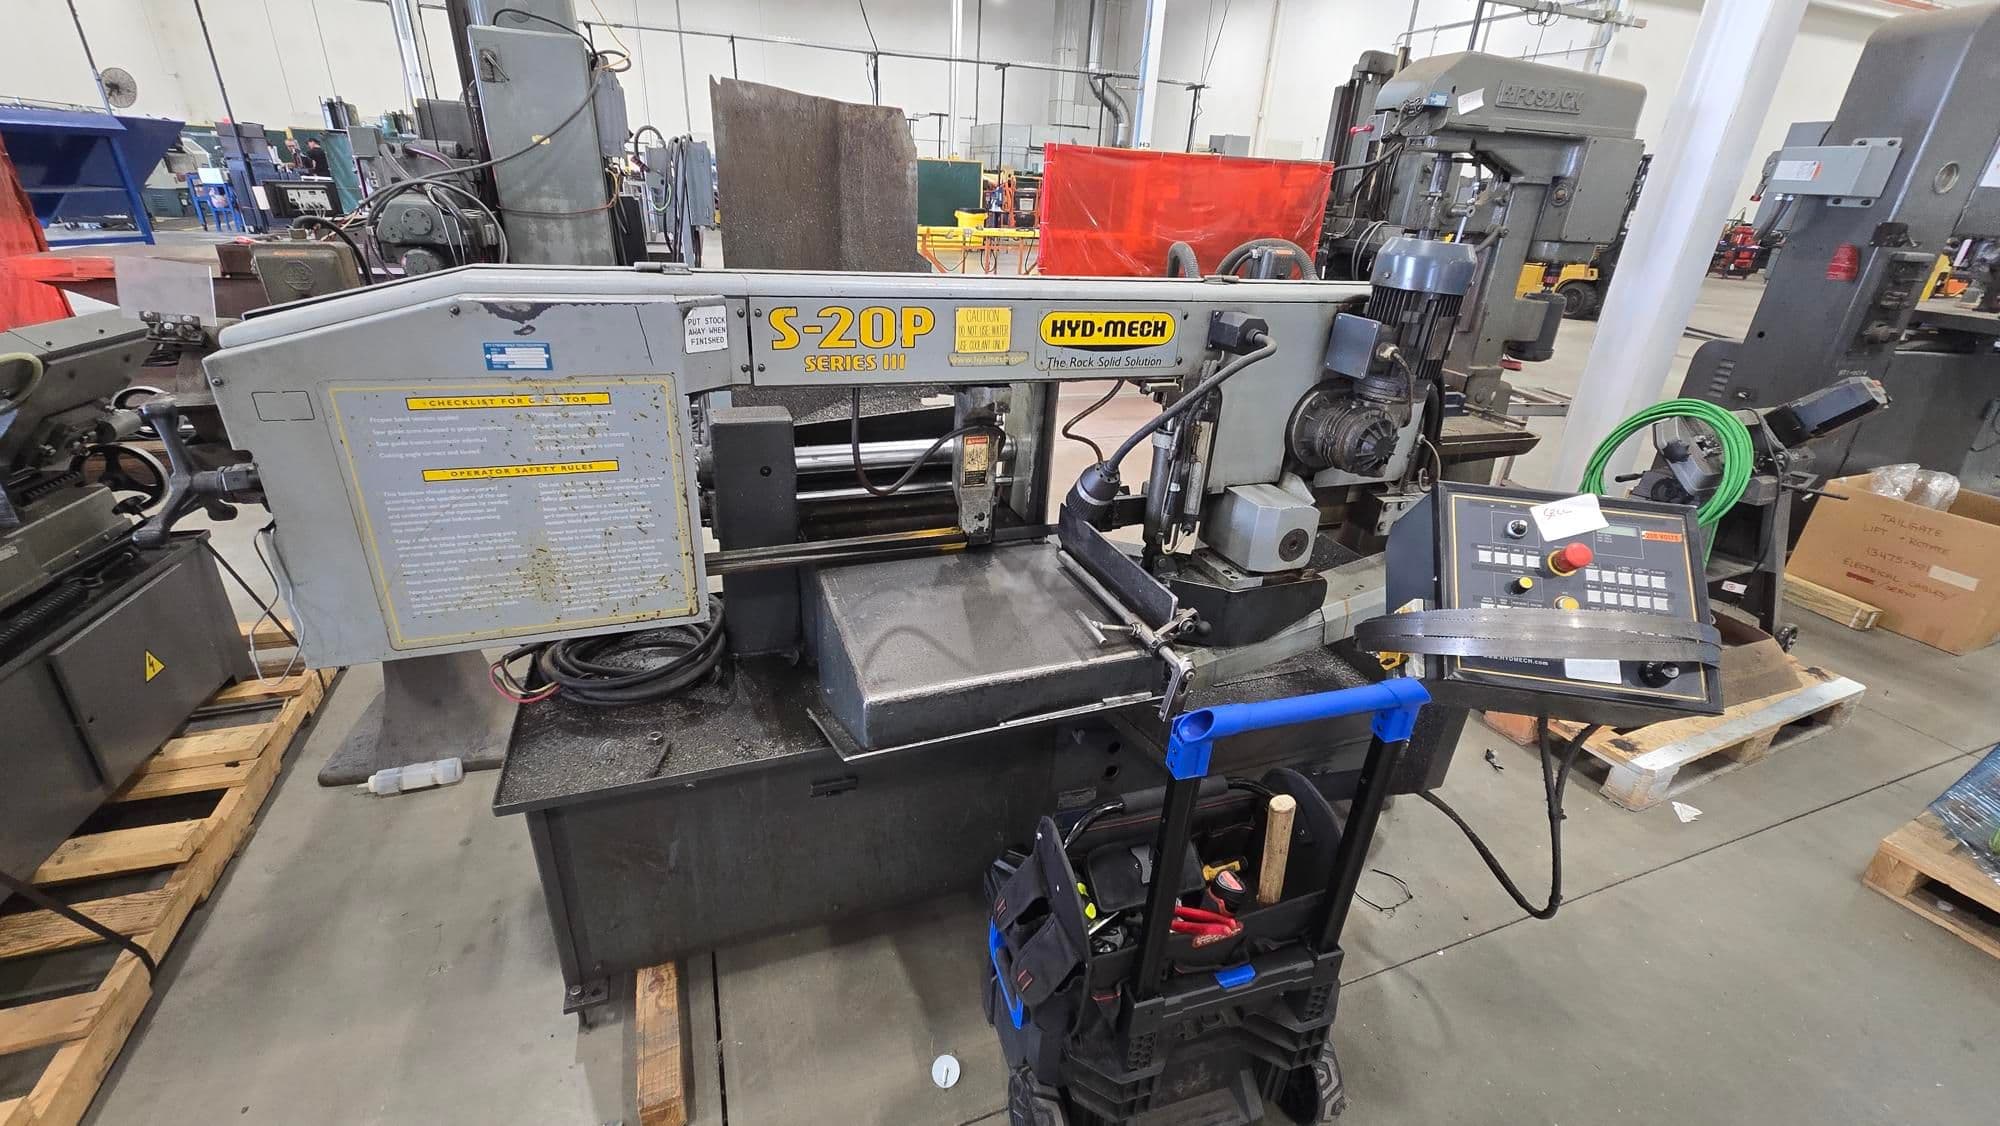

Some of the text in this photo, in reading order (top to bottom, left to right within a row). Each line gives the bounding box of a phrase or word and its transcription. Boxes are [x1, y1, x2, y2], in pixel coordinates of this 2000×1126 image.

[687, 316, 725, 326] PUT STOCK
[966, 309, 1000, 323] CAUTION
[688, 326, 726, 336] AWAY WHEN
[768, 305, 936, 350] S-20P
[967, 325, 977, 336] NOT
[691, 336, 725, 346] FINISHED
[804, 352, 906, 372] SERIES III
[1047, 356, 1162, 368] The Rock Solid Solution
[429, 398, 494, 407] CHECKLIST
[501, 397, 523, 405] FOR
[450, 463, 593, 477] OPERATOR SAFETY RULES
[1863, 523, 1888, 536] LIFT
[1881, 513, 1944, 537] TAILGATE
